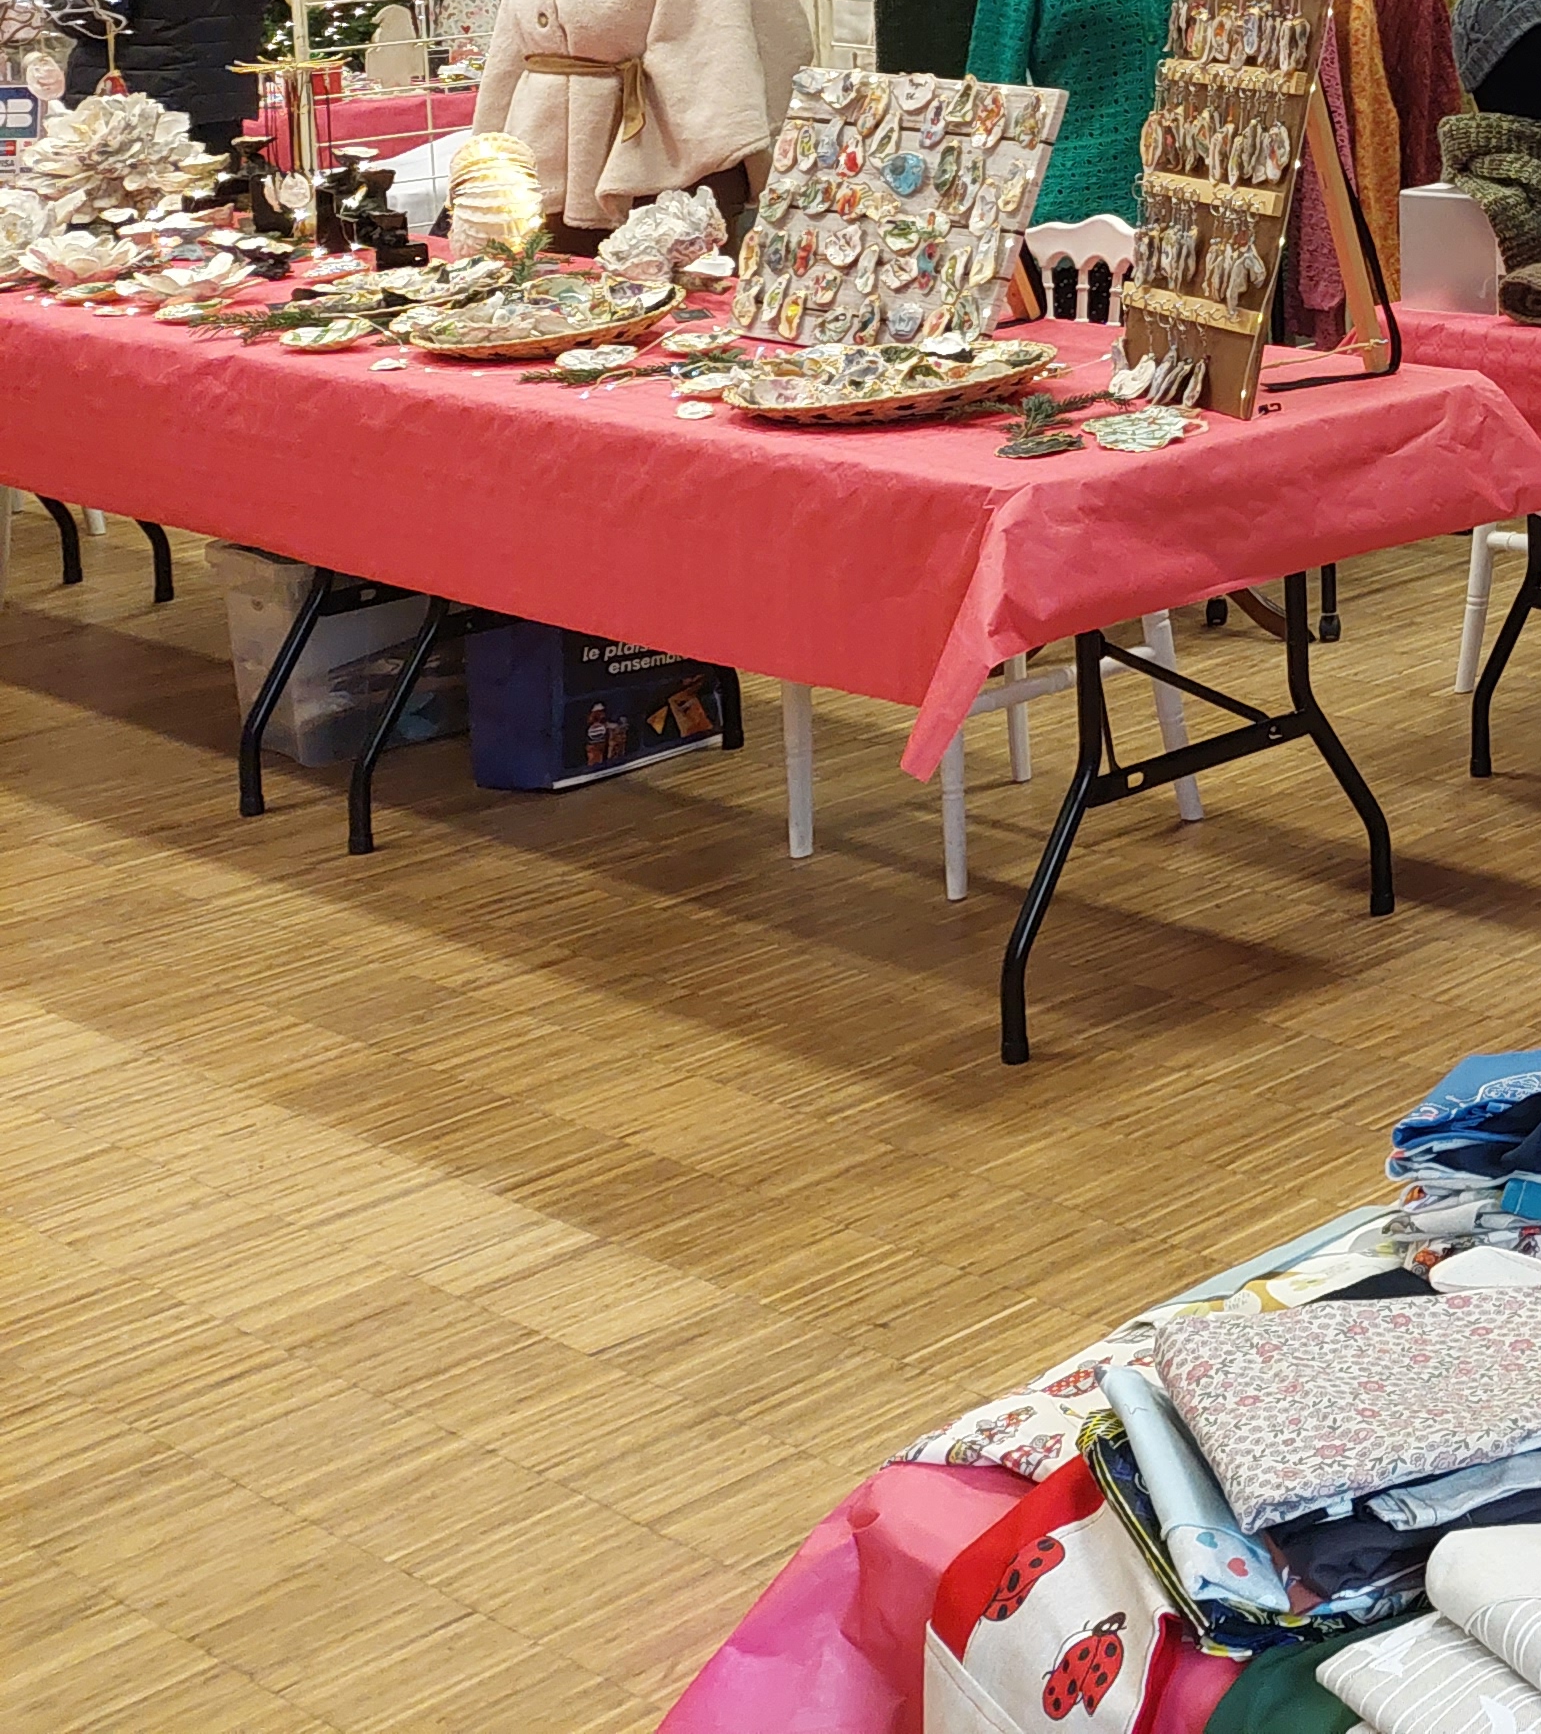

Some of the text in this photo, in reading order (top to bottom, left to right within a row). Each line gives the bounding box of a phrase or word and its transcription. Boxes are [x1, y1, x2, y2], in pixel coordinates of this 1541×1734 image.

[582, 641, 654, 662] le plais
[607, 653, 690, 675] ensemb
